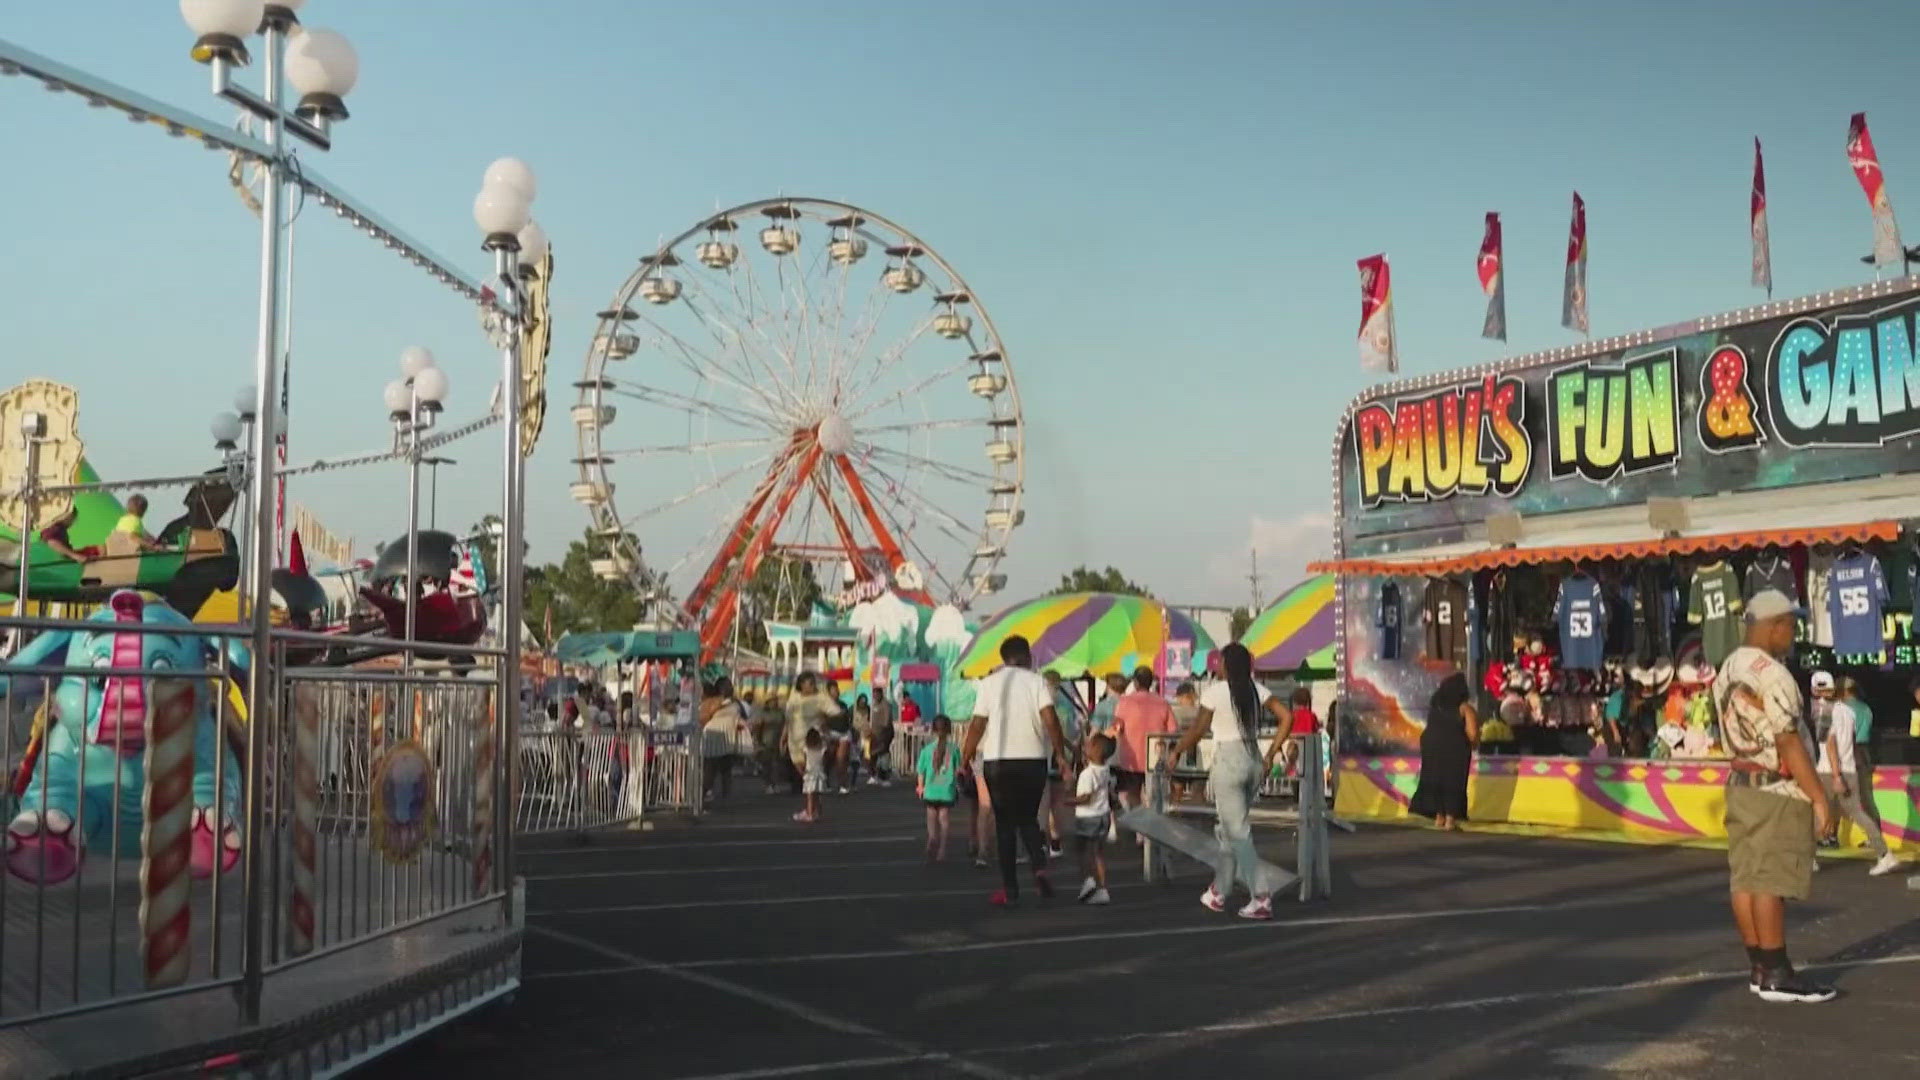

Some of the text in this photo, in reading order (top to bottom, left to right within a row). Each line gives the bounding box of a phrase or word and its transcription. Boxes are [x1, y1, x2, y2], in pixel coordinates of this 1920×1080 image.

[1358, 374, 1528, 497] PAUL'S
[1556, 360, 1675, 467] FUN
[1706, 349, 1755, 438] &
[1438, 601, 1451, 625] 2
[1704, 590, 1726, 620] 12
[1839, 585, 1870, 617] 56
[1570, 611, 1593, 638] 53
